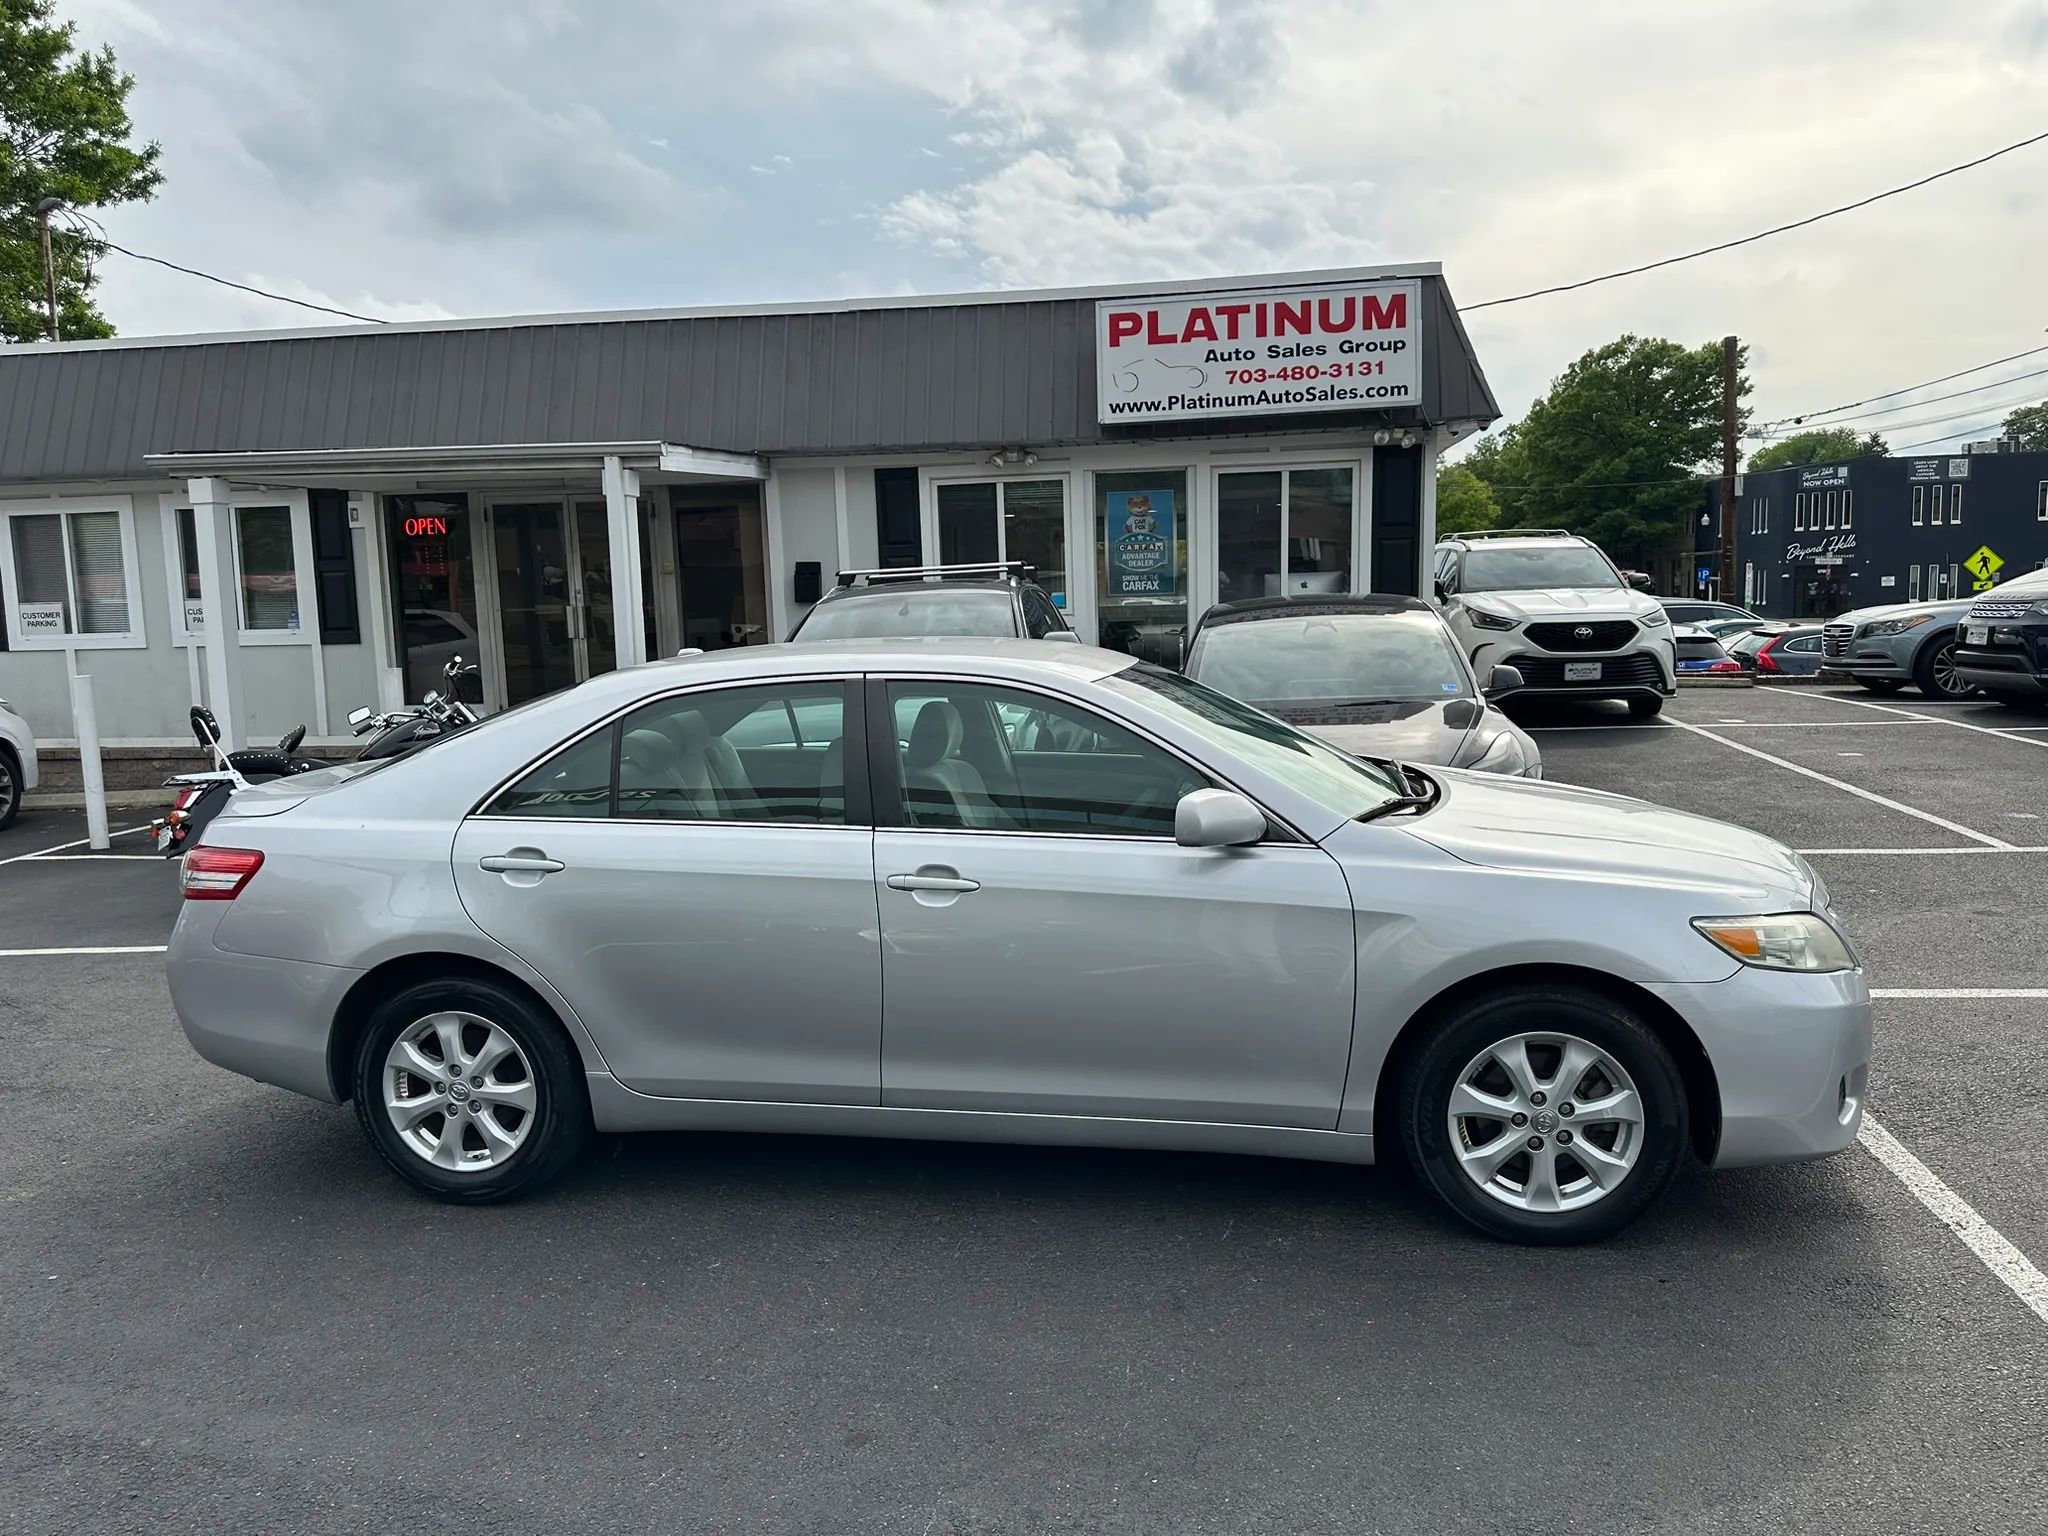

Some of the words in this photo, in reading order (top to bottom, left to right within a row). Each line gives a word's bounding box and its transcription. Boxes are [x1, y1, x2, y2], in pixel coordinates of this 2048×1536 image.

[1108, 293, 1407, 348] PLATINUM
[1204, 348, 1256, 363] Auto
[1267, 342, 1328, 359] Sales
[1338, 339, 1407, 354] Group
[1225, 360, 1384, 385] 703-480-3131
[1109, 384, 1409, 414] www.PlatinumAutoSales.com
[405, 517, 446, 536] OPEN
[1119, 543, 1164, 552] CARFAX
[1121, 552, 1161, 560] ADVANTAGE
[1786, 538, 1827, 561] Beyond
[1828, 534, 1857, 553] Hello
[1122, 580, 1160, 591] CARFAX
[22, 611, 61, 620] CUSTOMER
